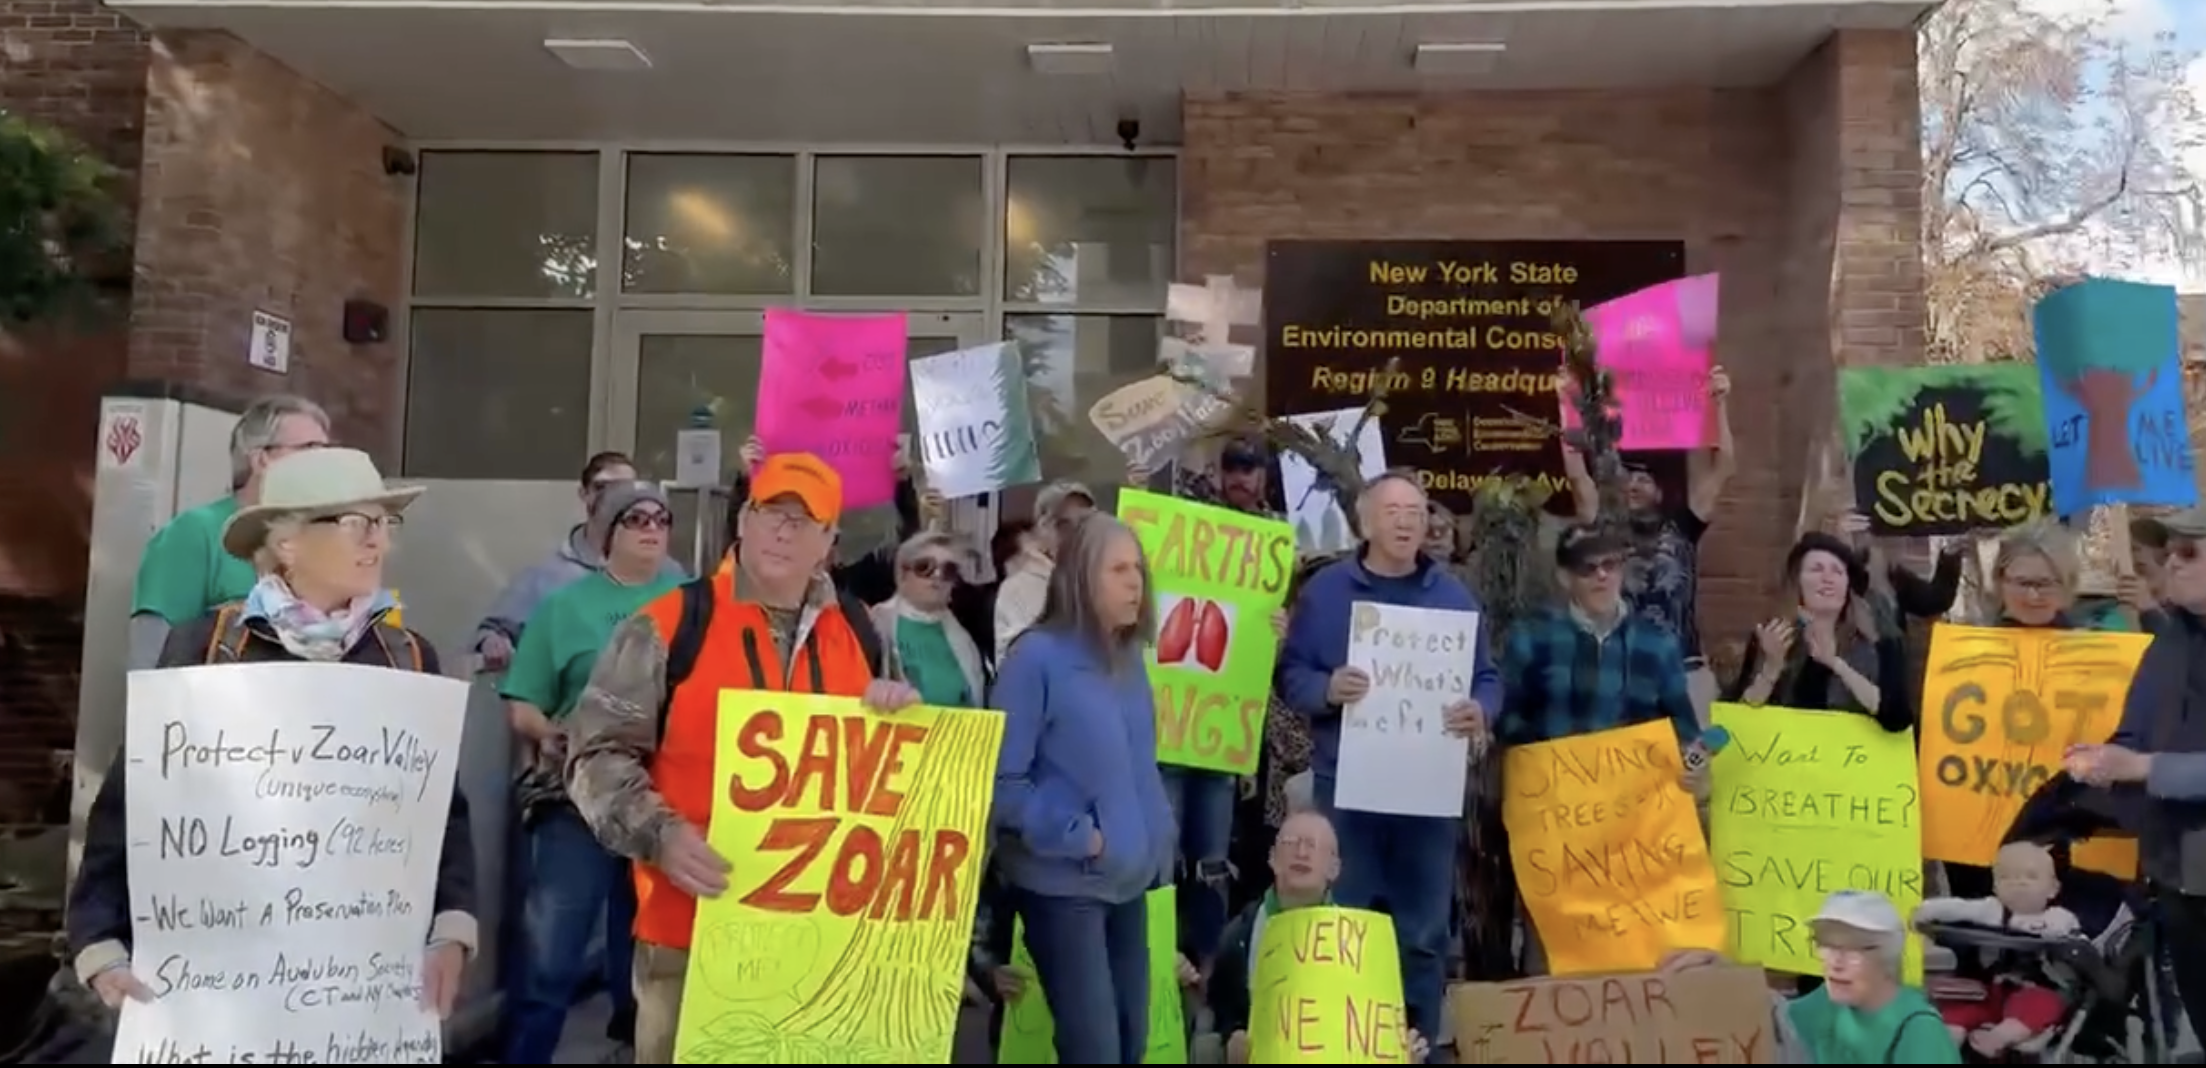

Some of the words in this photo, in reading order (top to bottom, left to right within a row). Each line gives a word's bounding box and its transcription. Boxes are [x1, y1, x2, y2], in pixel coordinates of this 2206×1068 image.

[1369, 261, 1427, 284] New
[1437, 261, 1498, 284] York
[1510, 261, 1578, 285] State
[1386, 295, 1530, 320] Department
[1282, 325, 1477, 349] Environmental
[1420, 366, 1437, 390] 9
[1899, 403, 1985, 463] Why
[2052, 413, 2089, 448] LET
[2137, 409, 2177, 438] ME
[1918, 459, 1977, 491] the
[1941, 681, 2110, 746] GOT
[161, 720, 286, 780] Protect
[310, 725, 378, 764] Zoar
[381, 726, 438, 803] Valley
[729, 709, 930, 817] SAVE
[1516, 738, 1673, 799] SAVING
[1731, 732, 1822, 766] Want
[1843, 745, 1869, 769] To
[1729, 782, 1917, 829] BREATHE?
[160, 815, 208, 861] NO
[219, 815, 320, 868] Logging
[325, 816, 364, 857] (92
[1527, 832, 1686, 898] SAVING
[738, 817, 970, 923] ZOAR
[1722, 850, 1836, 895] SAVE
[1847, 863, 1922, 898] OUR
[199, 899, 248, 930] Want
[258, 902, 273, 926] A
[283, 887, 383, 926] Preservation
[155, 954, 226, 999] Shame
[232, 972, 260, 990] on
[267, 951, 359, 985] Audubon
[1504, 977, 1678, 1034] ZOAR
[264, 1038, 318, 1064] the
